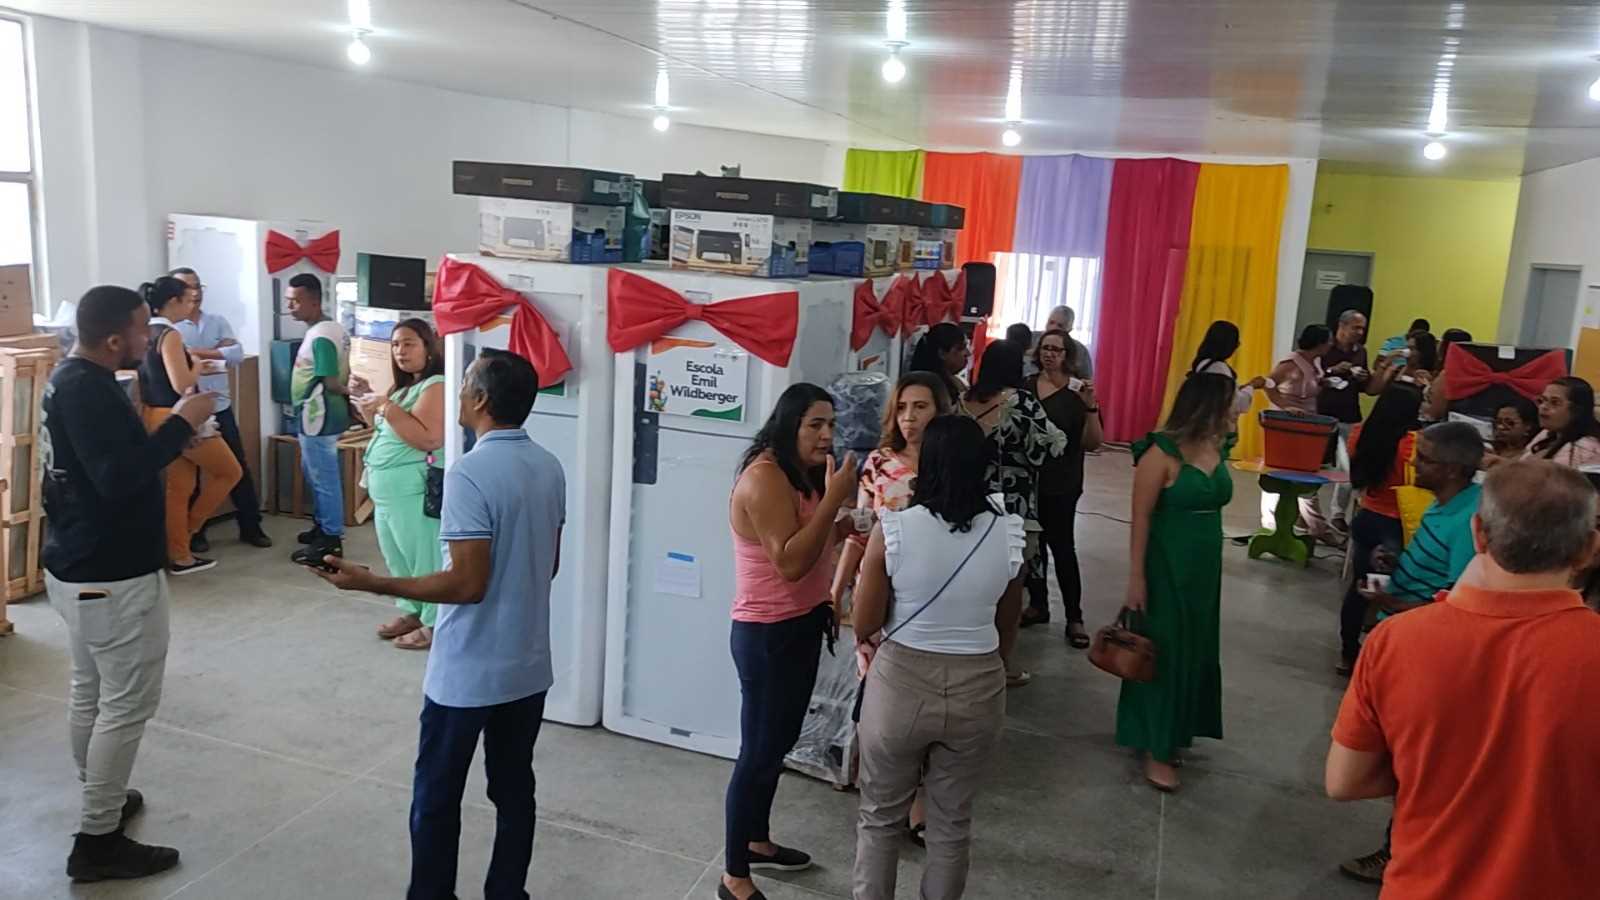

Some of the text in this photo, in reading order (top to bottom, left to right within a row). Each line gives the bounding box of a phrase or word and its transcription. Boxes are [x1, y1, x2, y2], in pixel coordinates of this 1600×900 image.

[686, 360, 724, 375] Escola
[691, 374, 717, 387] Emil
[670, 385, 739, 404] Wildberger
